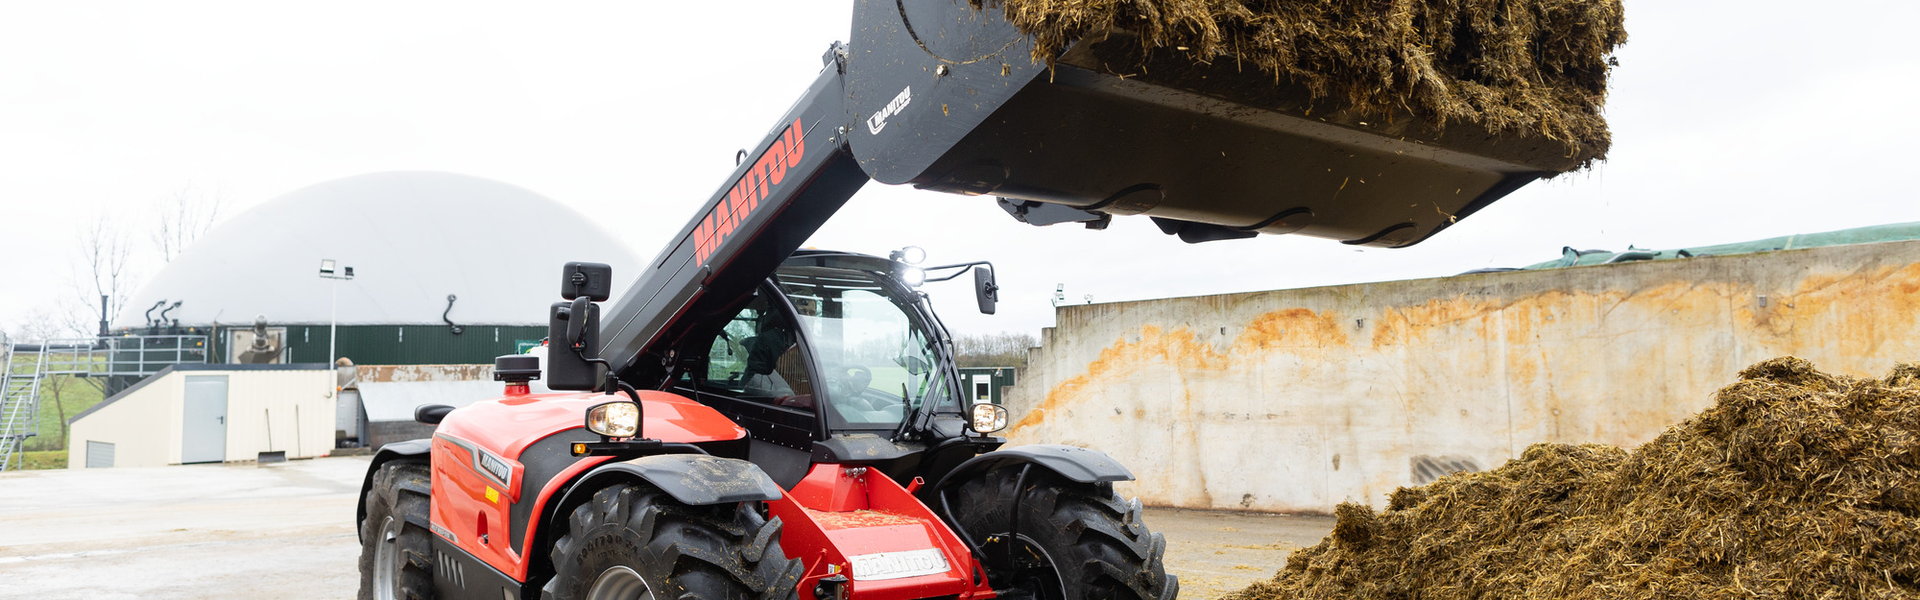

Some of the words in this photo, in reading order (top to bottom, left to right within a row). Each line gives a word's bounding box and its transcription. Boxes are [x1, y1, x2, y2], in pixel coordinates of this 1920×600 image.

[873, 85, 911, 127] MANITOU
[693, 116, 805, 268] MANITOU
[481, 453, 508, 480] MANITOU
[853, 549, 947, 577] MANITOU
